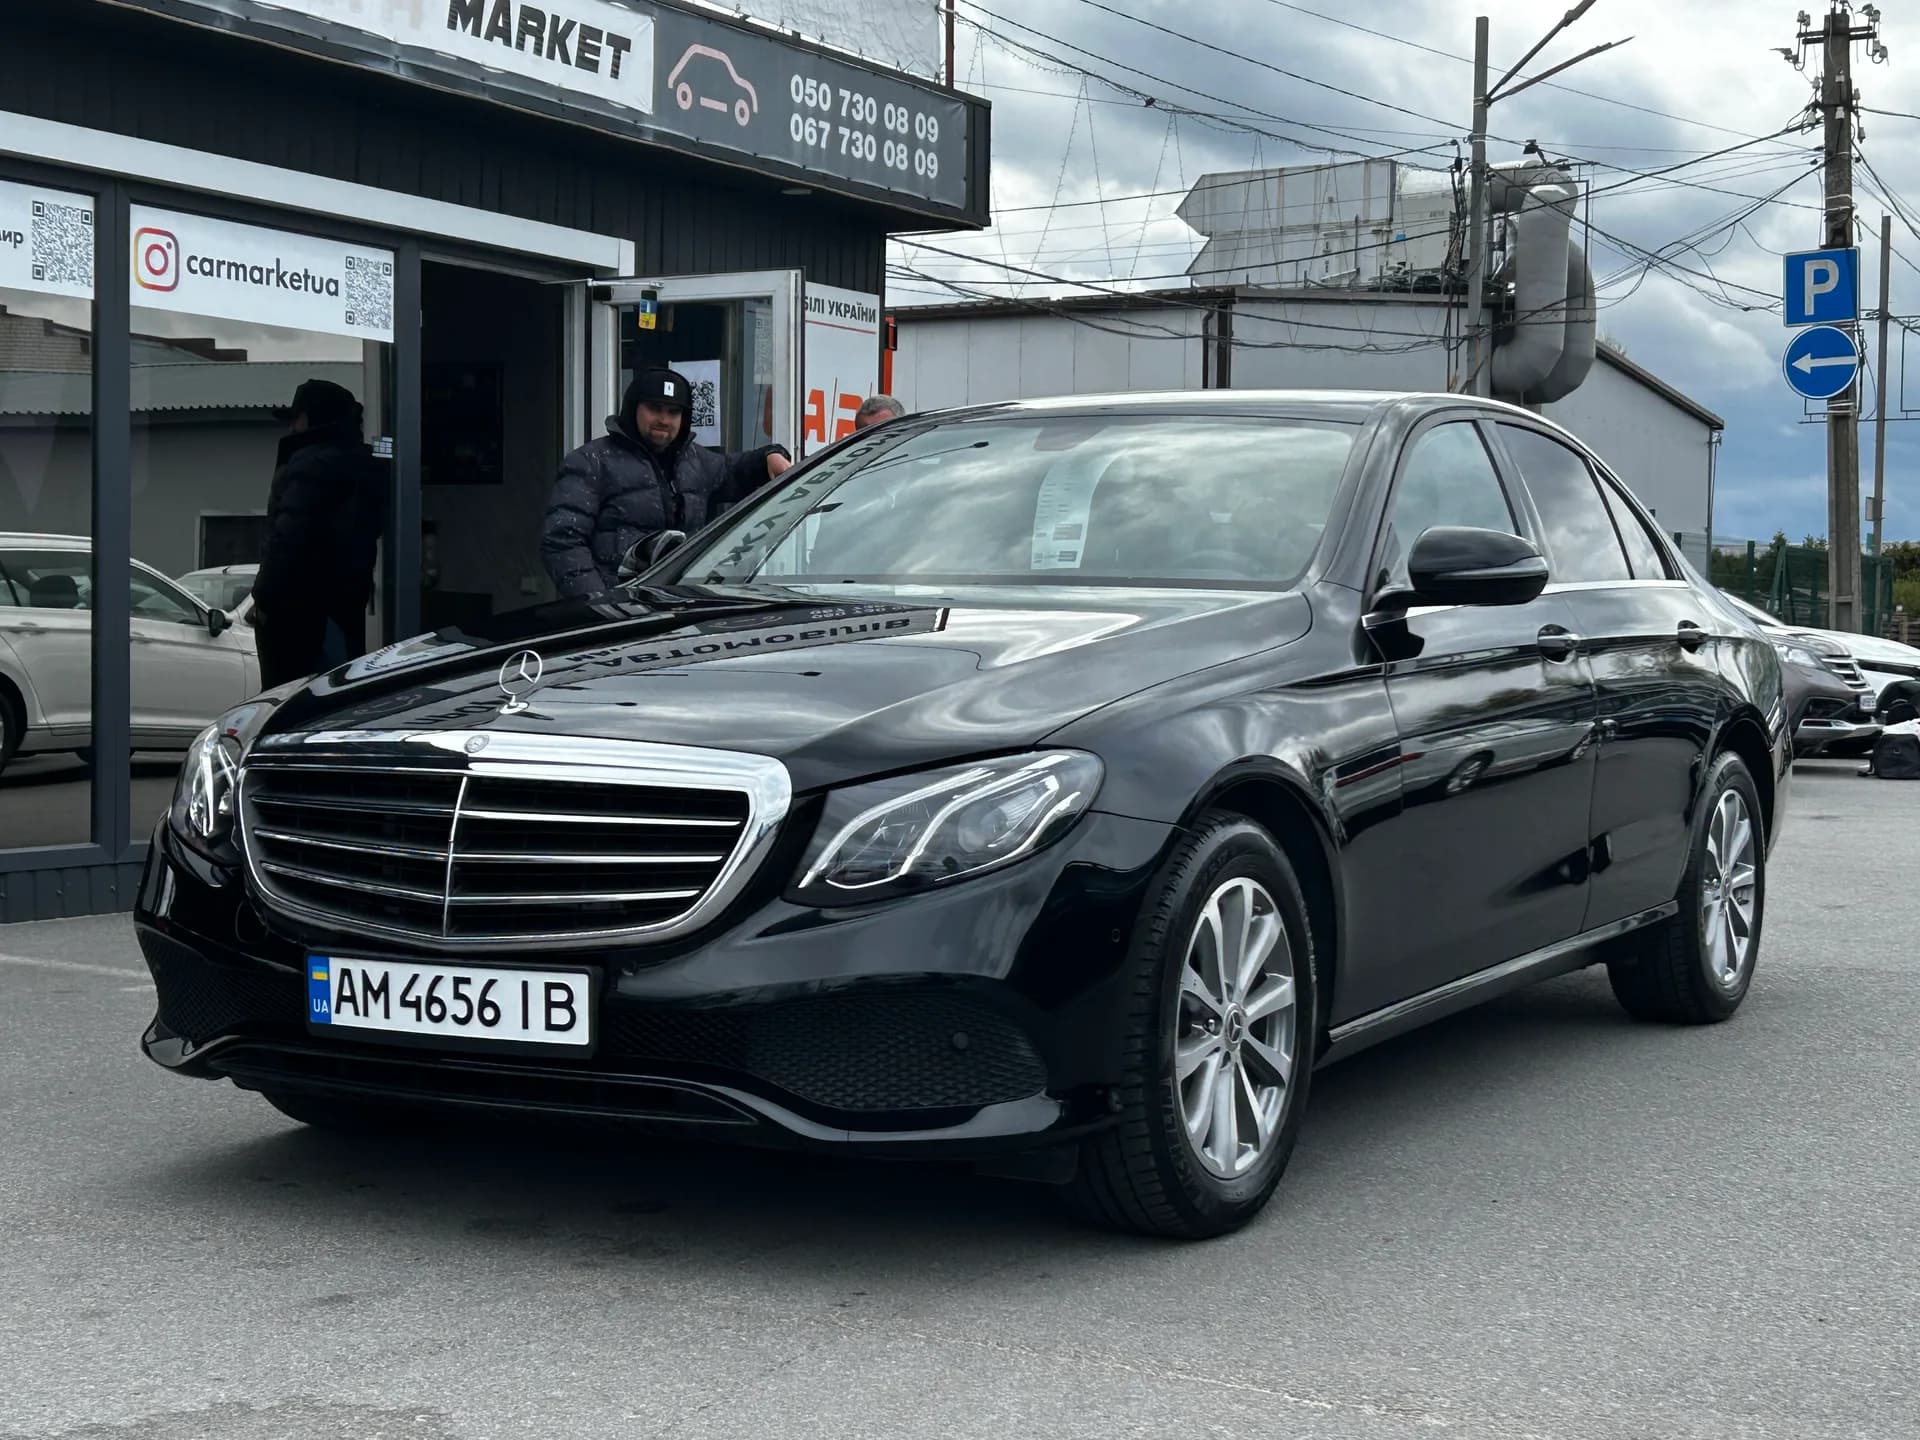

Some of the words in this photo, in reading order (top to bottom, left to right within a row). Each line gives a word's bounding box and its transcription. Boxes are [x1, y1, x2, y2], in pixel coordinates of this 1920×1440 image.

[446, 0, 632, 80] MARKET
[790, 74, 831, 112] 050
[838, 88, 877, 125] 730
[884, 103, 909, 134] 08
[914, 112, 939, 143] 09
[790, 113, 831, 150] 067
[838, 126, 877, 162] 730
[883, 139, 908, 170] 08
[914, 148, 939, 179] 09
[0, 229, 24, 249] ир
[186, 254, 339, 297] carmarketua
[1804, 259, 1840, 316] P
[828, 299, 876, 323] УКРАЇНИ
[312, 998, 330, 1014] UA
[334, 968, 390, 1020] AM
[399, 973, 501, 1028] 4656
[521, 979, 577, 1033] IB
